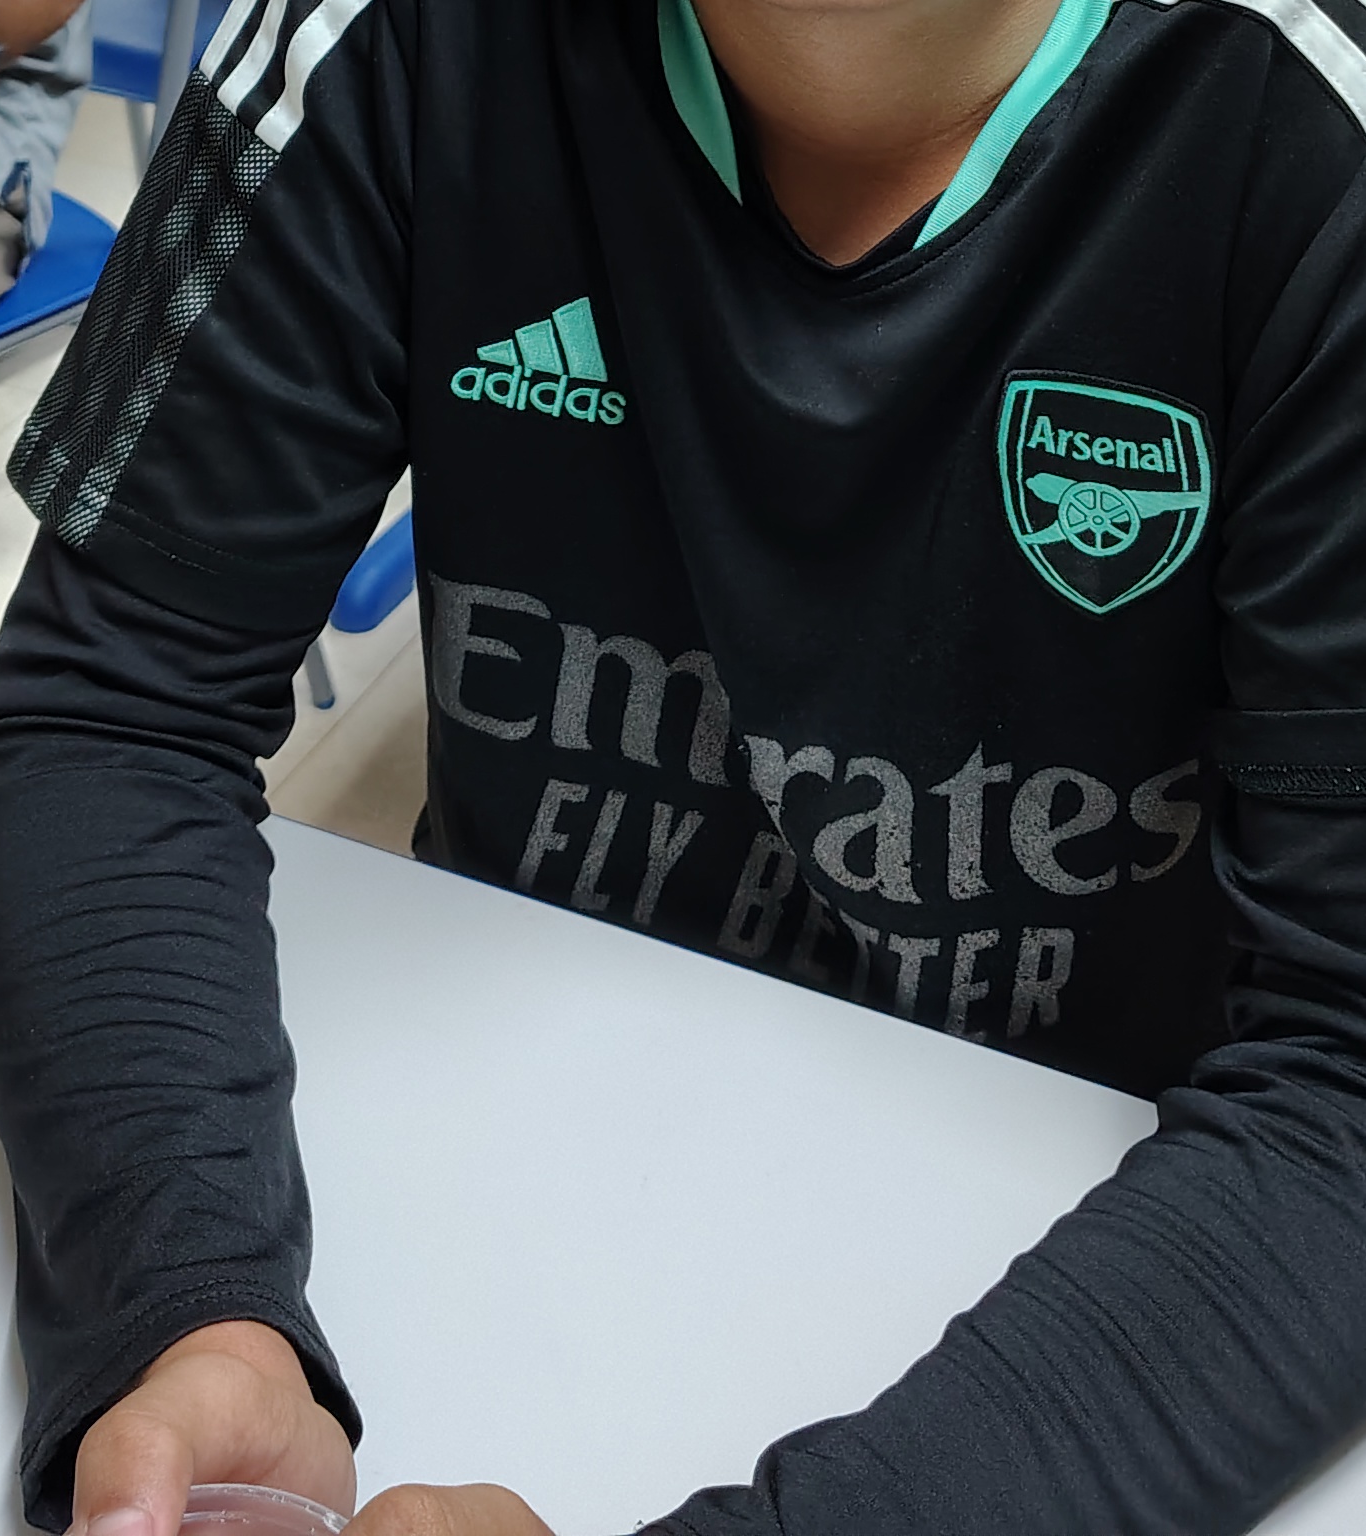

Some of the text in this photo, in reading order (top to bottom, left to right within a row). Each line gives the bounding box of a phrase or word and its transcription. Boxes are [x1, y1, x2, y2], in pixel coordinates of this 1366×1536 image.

[450, 365, 626, 426] adidas
[1028, 415, 1176, 473] Arsenal
[431, 572, 1202, 905] Emrates
[517, 777, 704, 925] FLY
